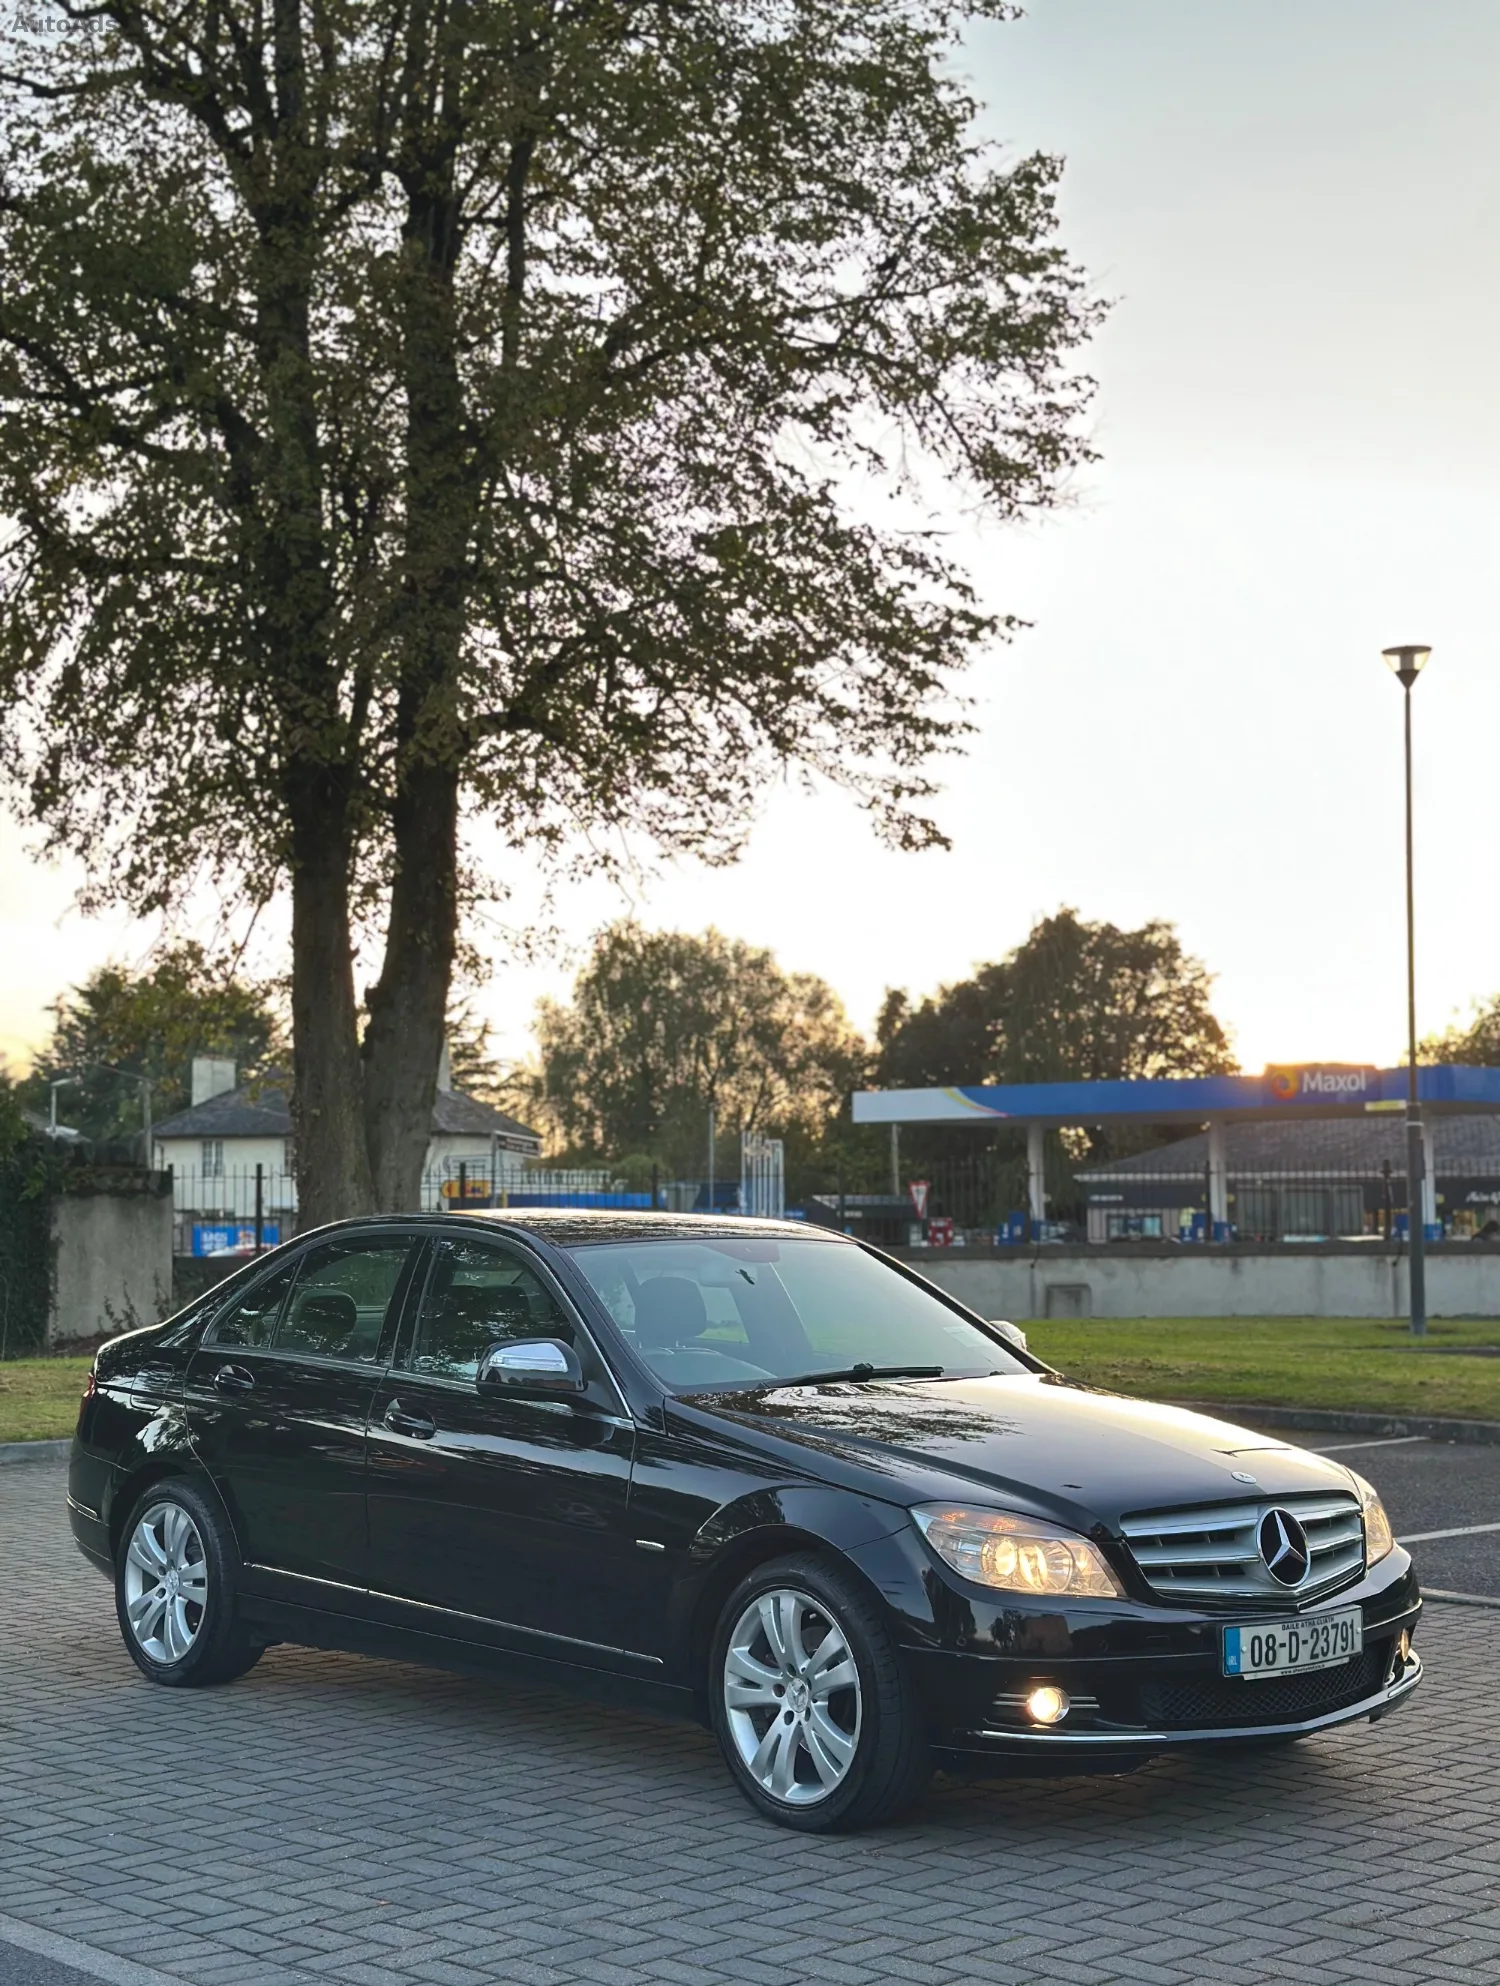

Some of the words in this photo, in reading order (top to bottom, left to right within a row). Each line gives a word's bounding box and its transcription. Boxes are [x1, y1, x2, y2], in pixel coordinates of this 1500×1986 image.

[1302, 1068, 1366, 1093] Maxol
[1281, 1622, 1300, 1631] BAILE
[1316, 1617, 1335, 1626] CLIATH
[1250, 1619, 1355, 1667] 08-D-23791
[1228, 1655, 1238, 1666] IRL
